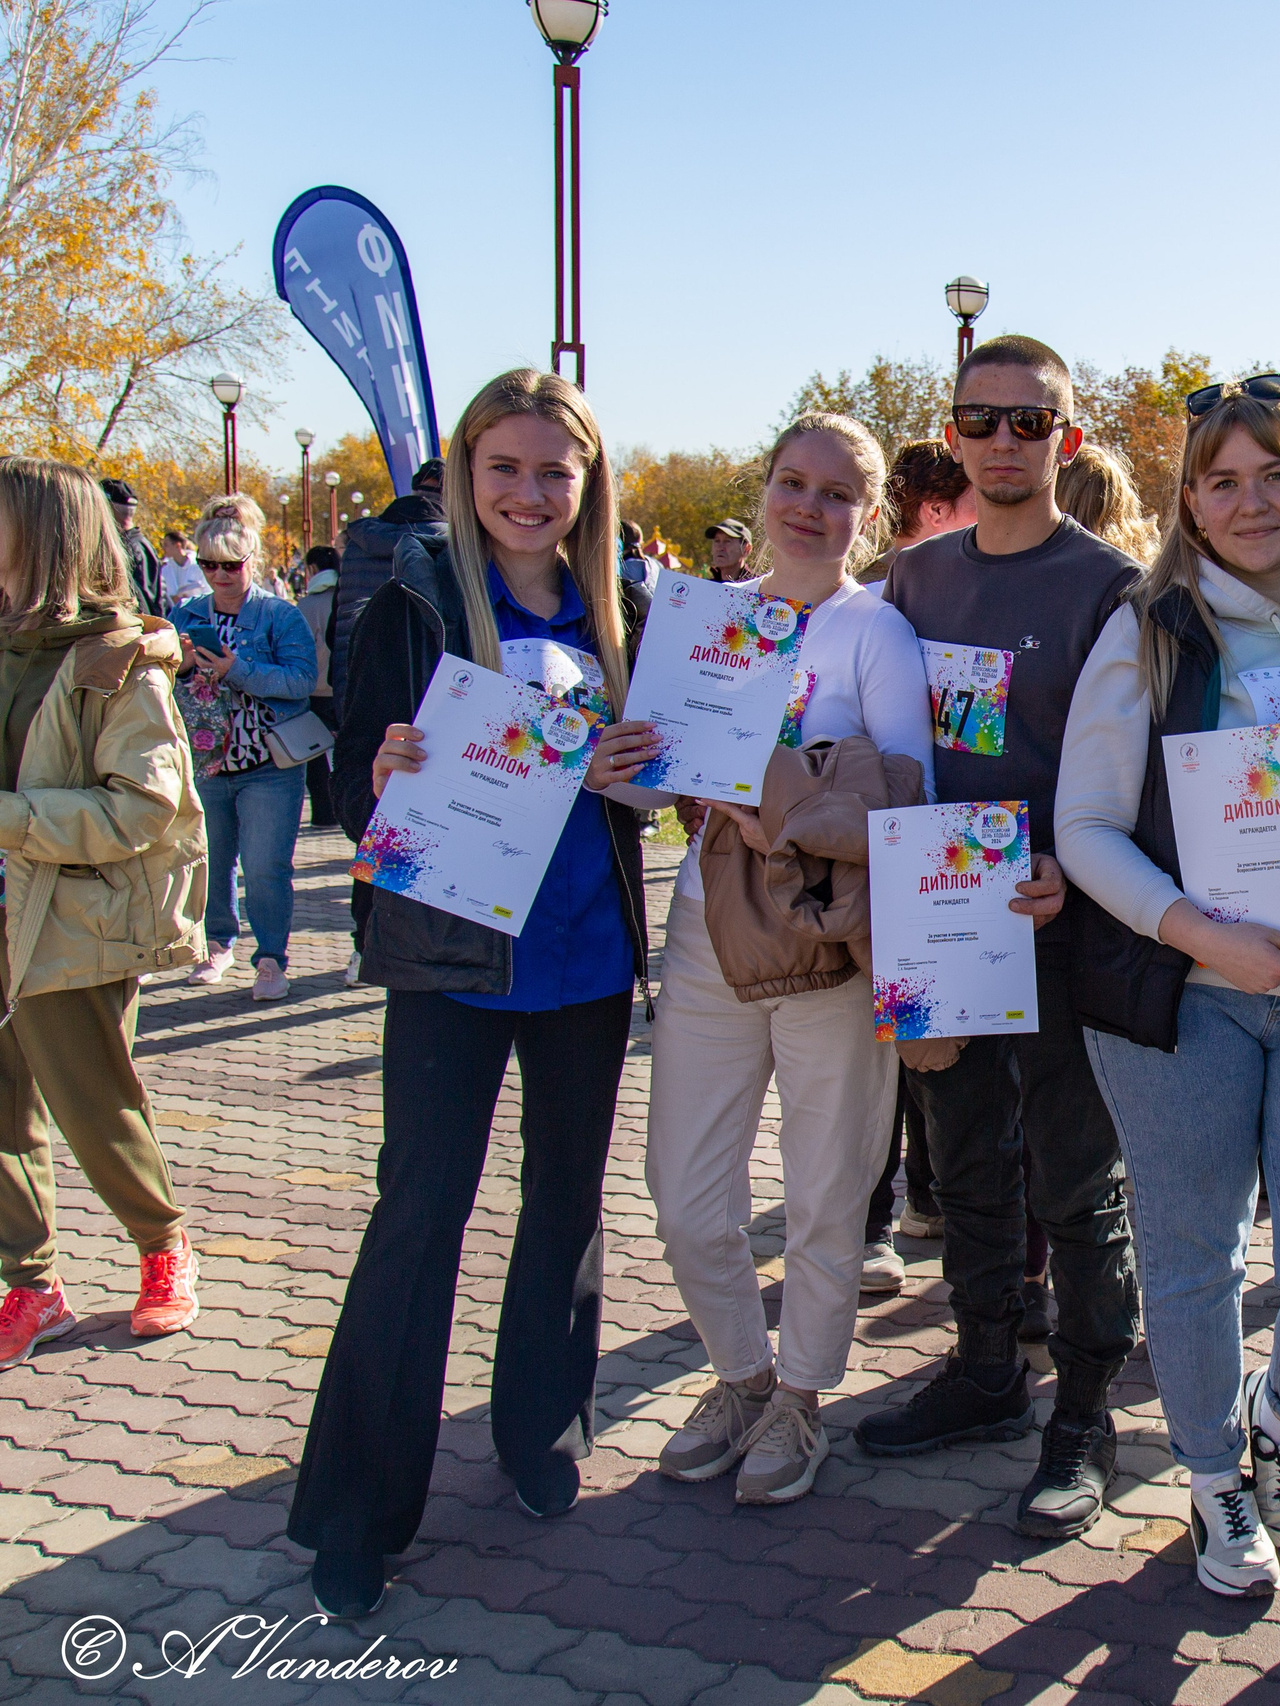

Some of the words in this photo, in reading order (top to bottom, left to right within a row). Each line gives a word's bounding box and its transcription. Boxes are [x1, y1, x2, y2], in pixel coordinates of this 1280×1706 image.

[690, 645, 751, 670] ДИПЛОМ
[699, 670, 734, 681] НАГРАЖДАЕТСЯ
[929, 684, 975, 738] 47
[462, 742, 531, 779] ДИПЛОМ
[471, 771, 509, 789] НАГРАЖДАЕТСЯ
[1240, 825, 1277, 834] НАГРАЖДАЕТСЯ
[919, 873, 981, 894] ДИПЛОМ
[933, 898, 969, 906] НАГРАЖДАЕТСЯ
